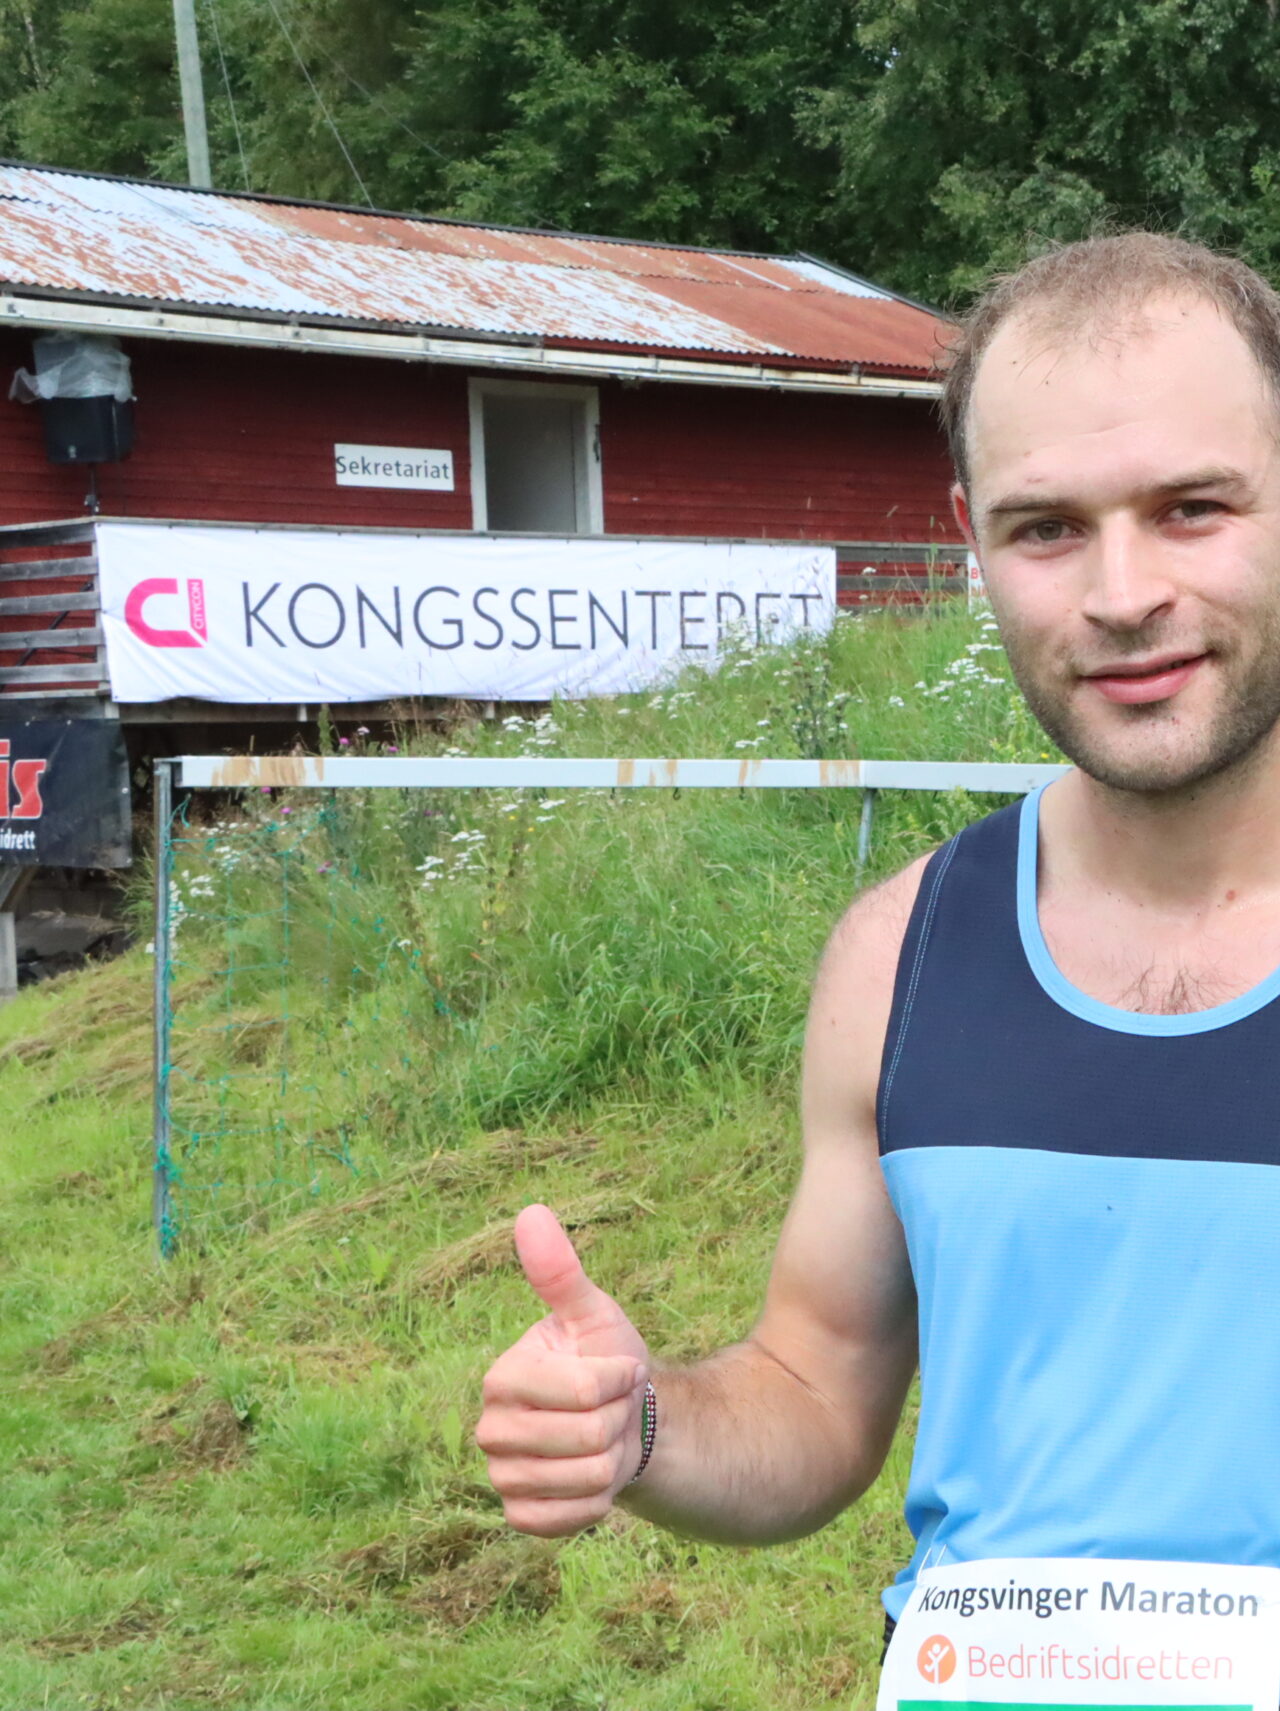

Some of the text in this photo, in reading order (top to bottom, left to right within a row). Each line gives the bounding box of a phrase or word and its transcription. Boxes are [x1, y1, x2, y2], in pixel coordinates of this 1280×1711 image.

[335, 455, 450, 480] Sekretariat
[190, 581, 205, 630] CITYCON
[917, 1579, 1259, 1618] Kongsvinger Maraton
[967, 1643, 1234, 1681] Bedriftsidretten
